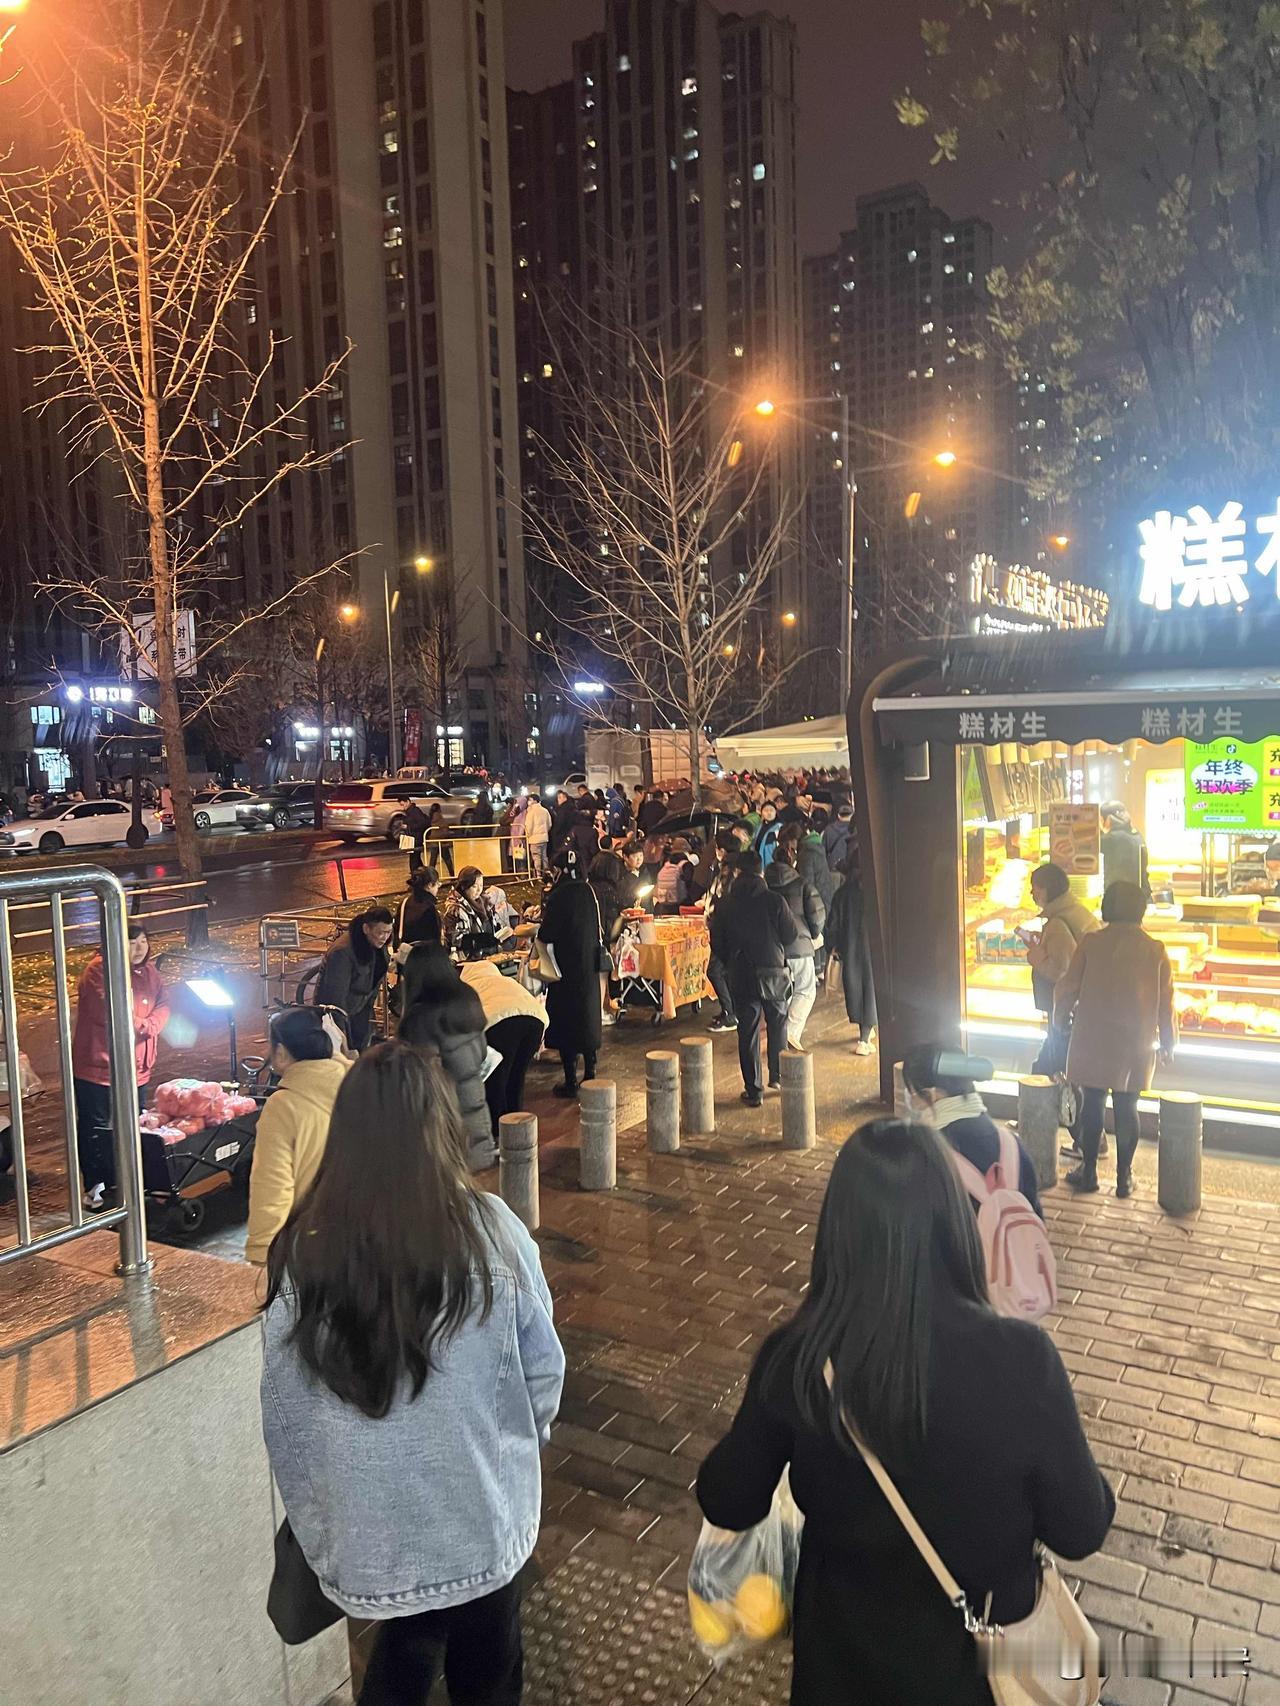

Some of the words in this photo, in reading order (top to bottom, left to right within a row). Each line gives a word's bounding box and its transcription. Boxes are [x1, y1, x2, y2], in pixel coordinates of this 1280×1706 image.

[1138, 496, 1280, 610] 糕
[959, 711, 1047, 739] 糕材生
[1141, 706, 1244, 738] 糕材生
[1205, 759, 1244, 775] 年终
[1195, 778, 1254, 795] 狂欢季
